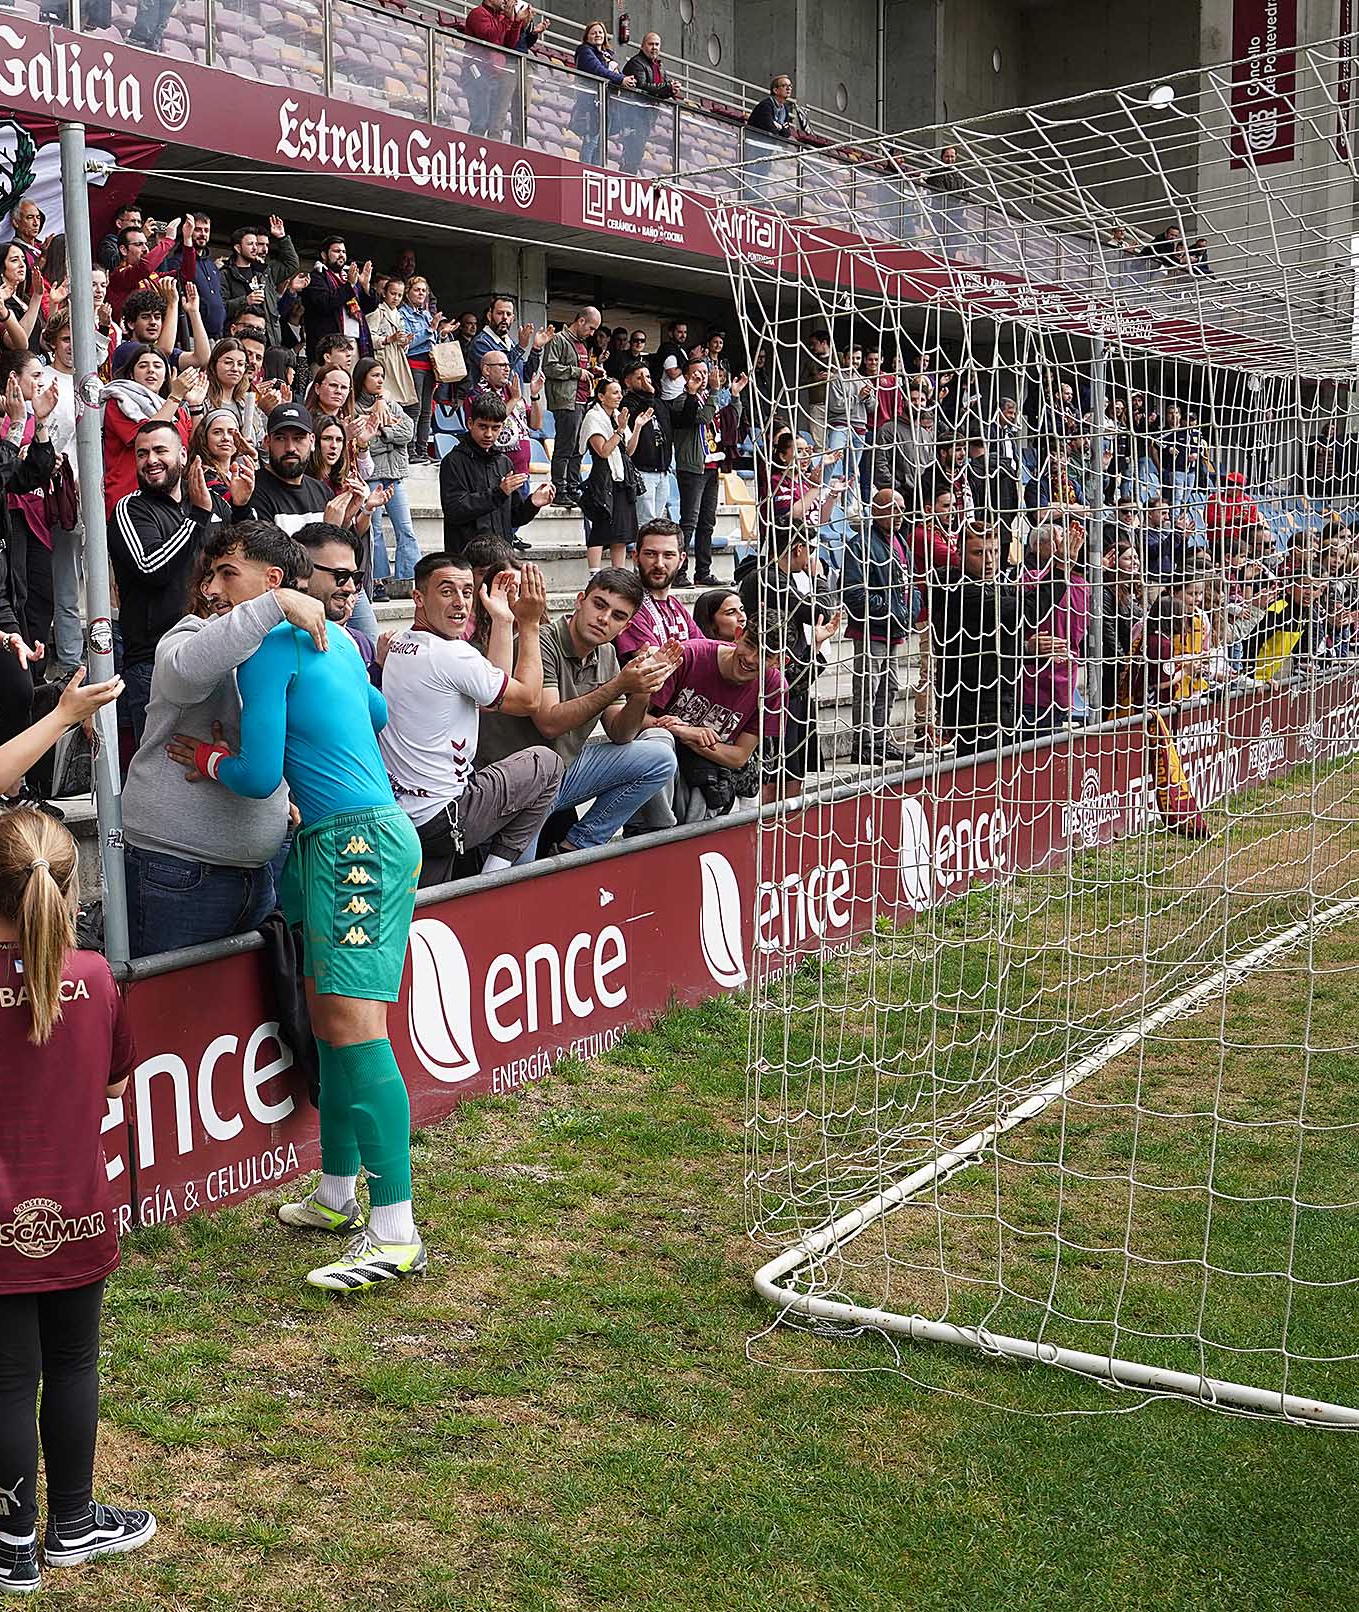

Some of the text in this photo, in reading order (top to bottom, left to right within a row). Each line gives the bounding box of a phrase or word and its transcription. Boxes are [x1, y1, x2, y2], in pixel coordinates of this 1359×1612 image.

[1246, 36, 1261, 97] Concello
[1264, 0, 1278, 74] Pontevedr
[276, 97, 505, 203] Estrella Galicia
[606, 217, 638, 234] CERÁMICA
[607, 176, 684, 227] PUMAR
[935, 808, 1008, 888] ence
[753, 858, 851, 955] ence
[484, 924, 628, 1043] ence
[492, 1046, 552, 1094] ENERGÍA
[12, 1197, 63, 1216] CONSERVAS
[183, 1180, 201, 1213] &
[205, 1142, 300, 1203] CELULOSA
